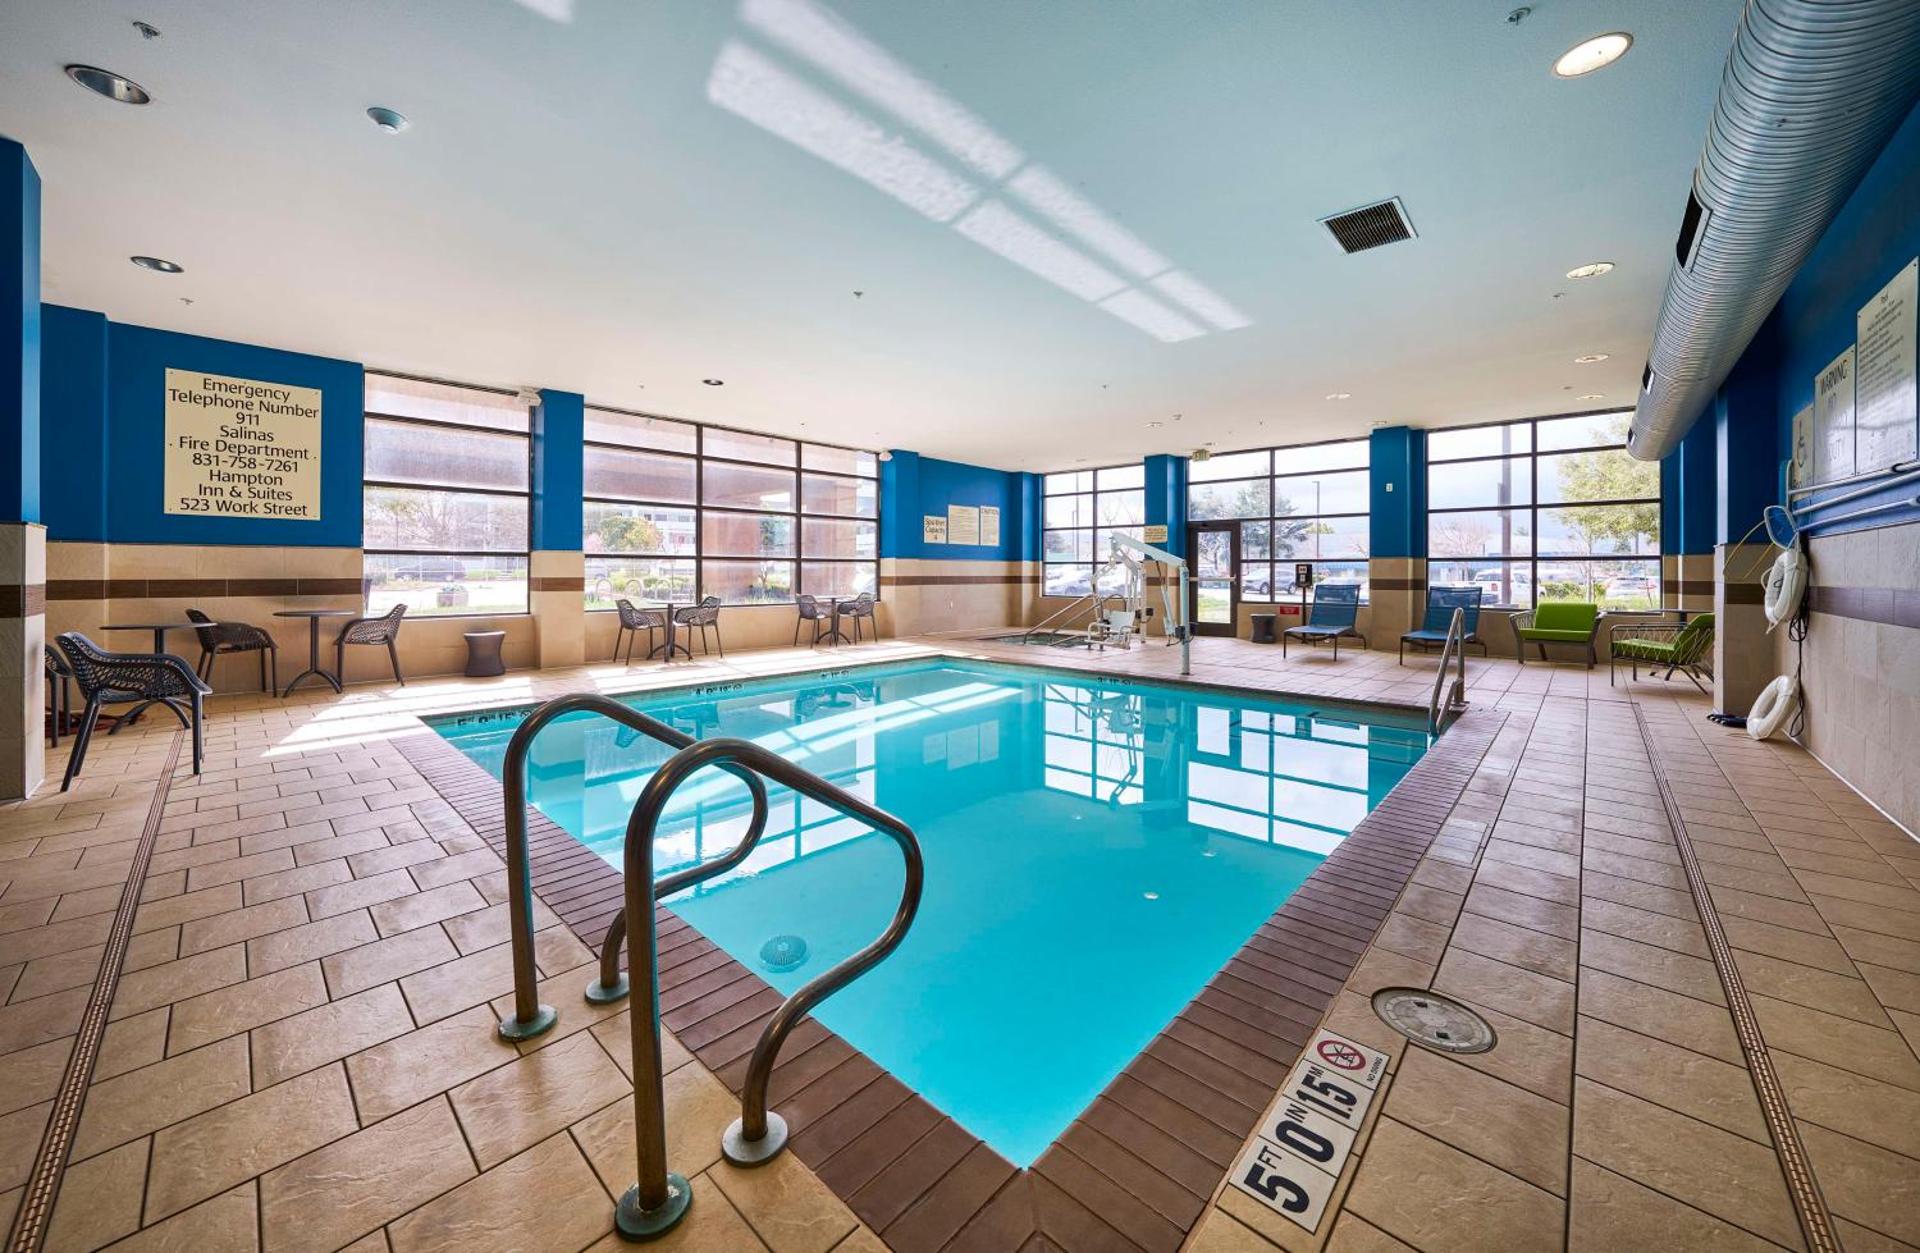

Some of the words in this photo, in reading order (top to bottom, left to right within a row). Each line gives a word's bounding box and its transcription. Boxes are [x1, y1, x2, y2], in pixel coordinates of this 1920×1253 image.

[203, 377, 290, 403] Emergency
[168, 388, 254, 411] Telephone
[259, 400, 319, 418] Number
[236, 411, 260, 426] 911
[220, 425, 274, 442] Salinas
[179, 436, 210, 451] Fire
[215, 439, 309, 460] Department
[192, 452, 298, 473] 831-758-7261
[209, 469, 283, 487] Hampton
[198, 483, 224, 497] Inn
[229, 485, 242, 498] &
[248, 487, 293, 501] Suites
[180, 497, 209, 511] 523
[216, 499, 257, 514] Work
[263, 502, 308, 516] Street
